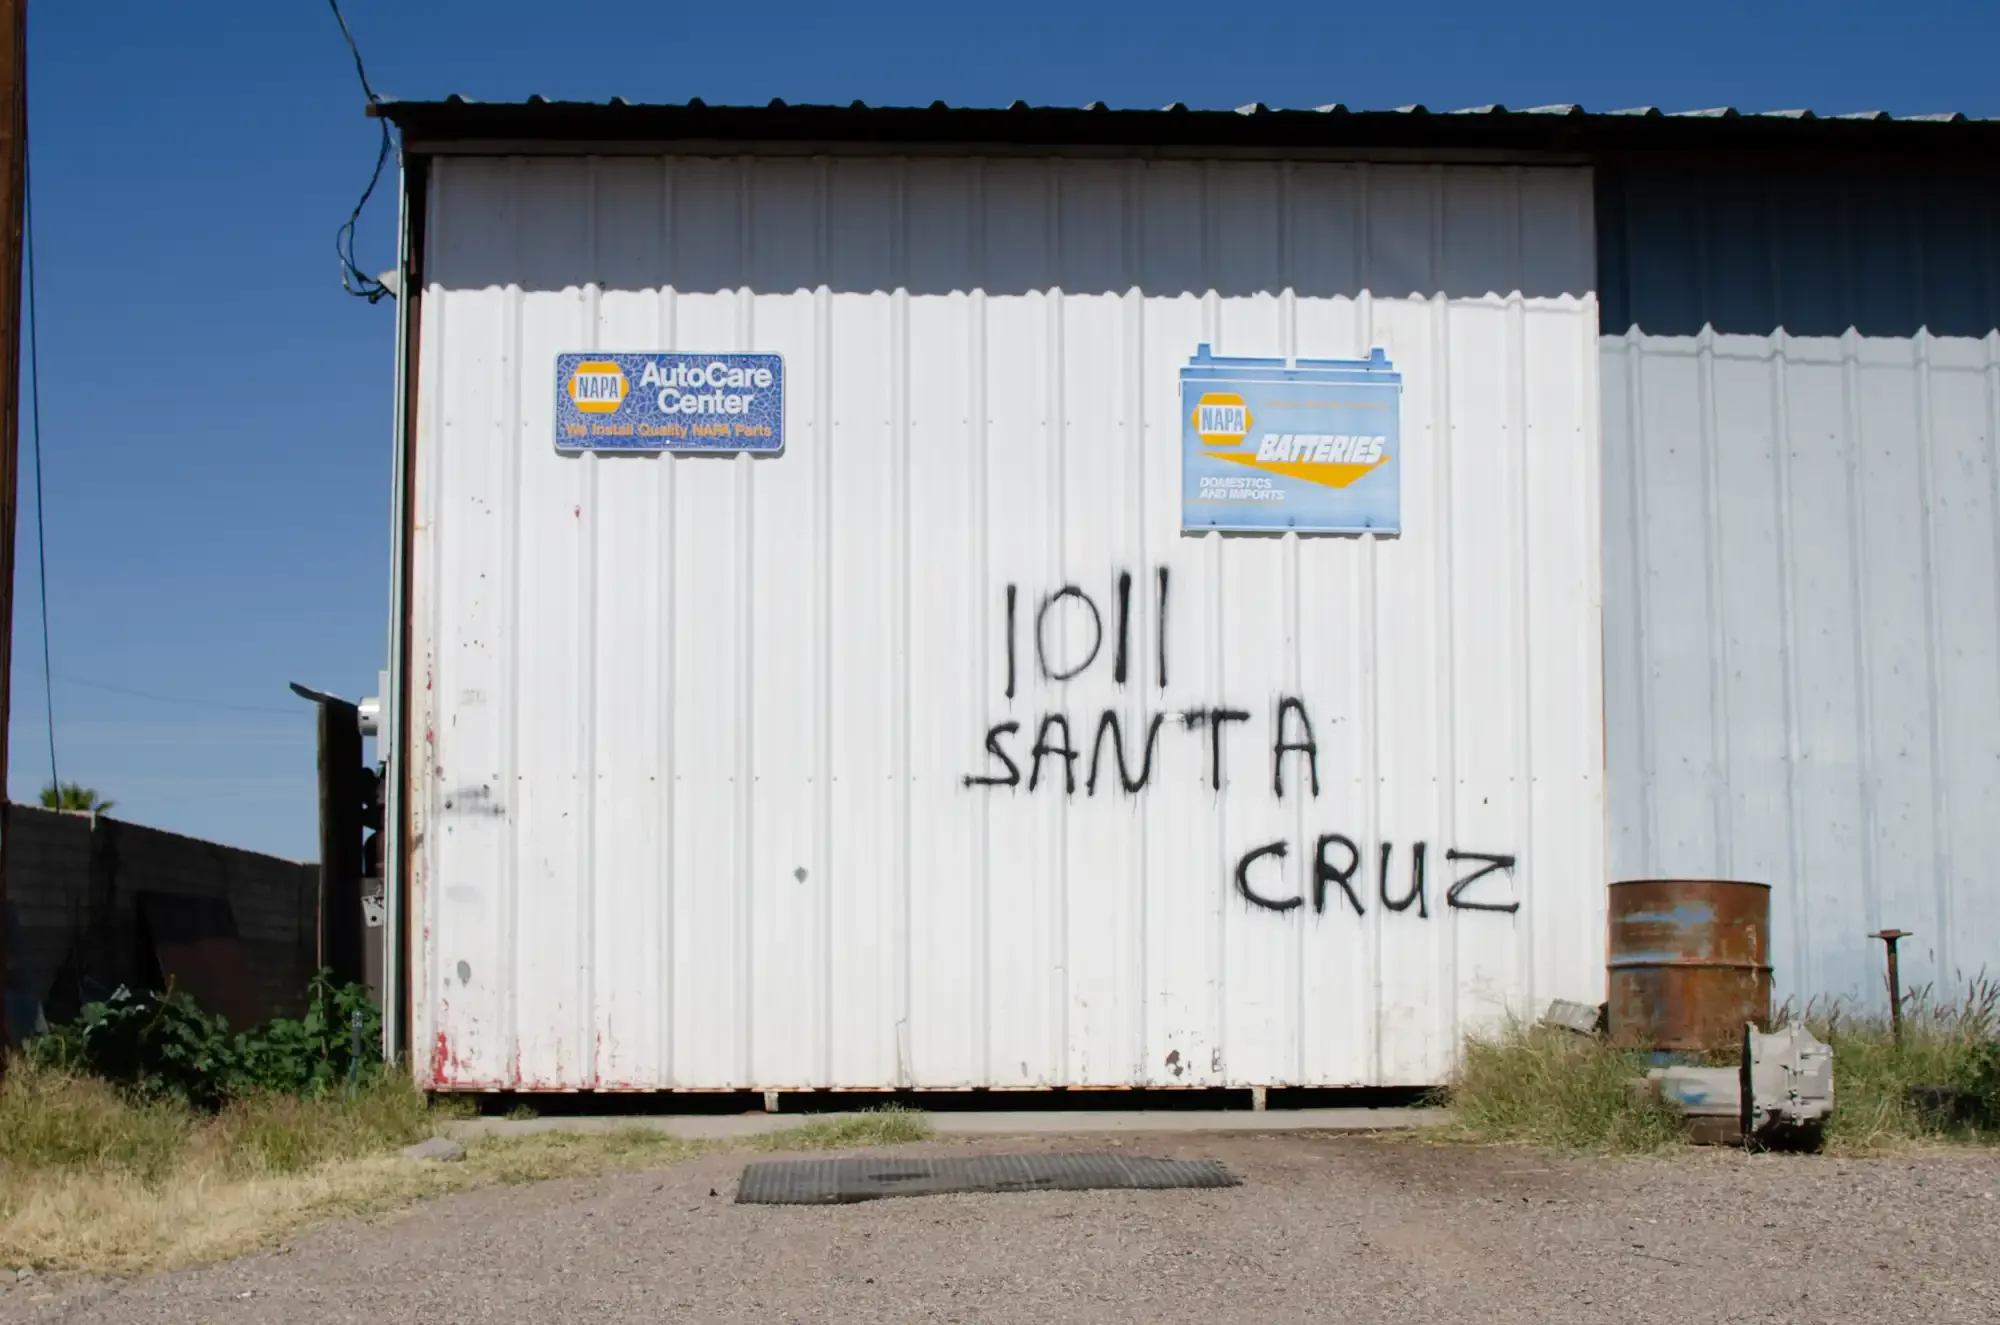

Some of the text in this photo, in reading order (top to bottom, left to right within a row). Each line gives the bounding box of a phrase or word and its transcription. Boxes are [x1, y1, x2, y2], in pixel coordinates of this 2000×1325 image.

[578, 375, 620, 400] NAPA
[640, 361, 773, 388] AutoCare
[658, 388, 755, 414] Center
[566, 423, 772, 439] We Install Quality NAPA Parts
[1201, 406, 1245, 432] NAPA
[1256, 433, 1386, 465] BATTERIES
[1199, 476, 1273, 489] DOMESTICS
[1199, 488, 1286, 501] AND IMPORTS
[1006, 565, 1169, 699] 1011
[962, 697, 1320, 798] SANTA
[1235, 833, 1520, 918] CRUZ
